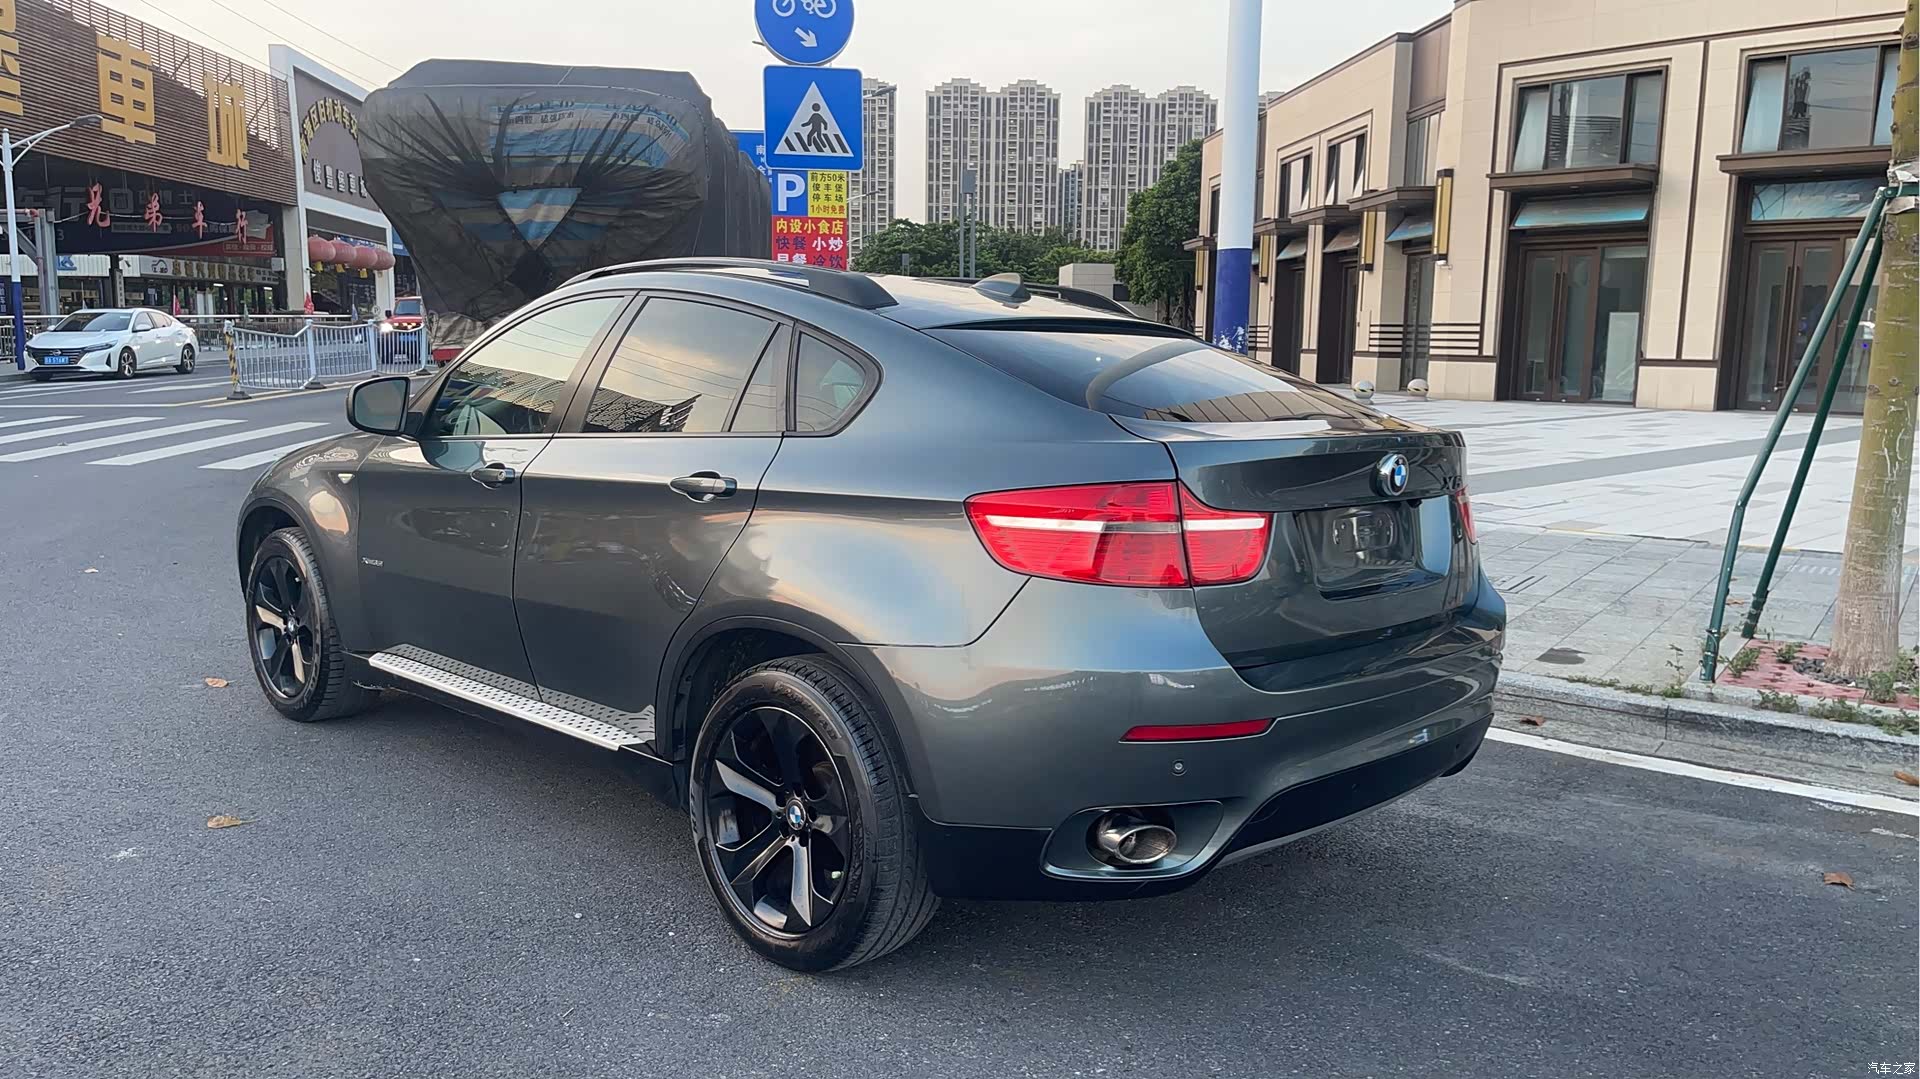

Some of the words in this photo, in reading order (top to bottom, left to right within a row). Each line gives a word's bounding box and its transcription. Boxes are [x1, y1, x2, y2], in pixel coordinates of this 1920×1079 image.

[810, 172, 845, 182] 前方50米
[778, 174, 805, 211] P
[812, 193, 844, 203] 停车场
[810, 204, 845, 214] 1小时免费
[776, 218, 844, 235] 内设小食店
[776, 235, 806, 250] 快餐
[812, 236, 844, 251] 小炒
